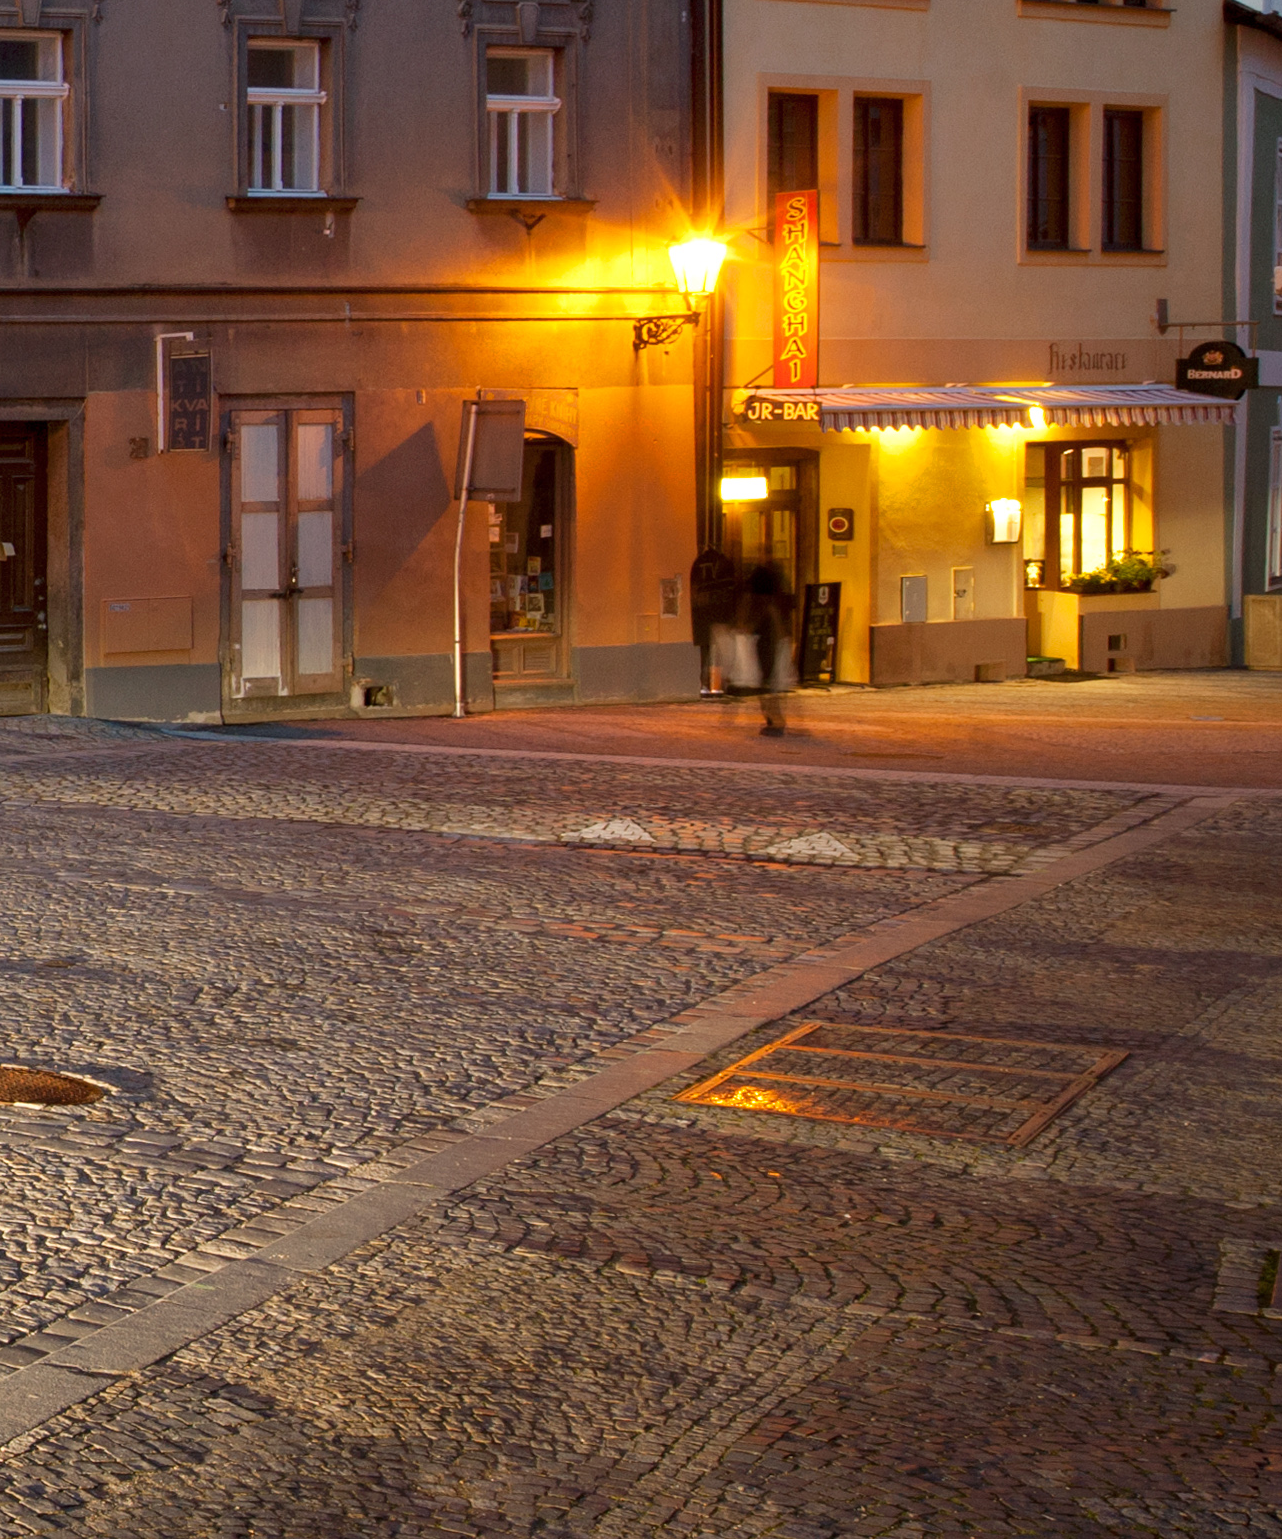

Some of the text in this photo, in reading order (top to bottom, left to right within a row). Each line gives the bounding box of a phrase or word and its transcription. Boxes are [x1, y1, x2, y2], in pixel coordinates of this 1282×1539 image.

[780, 197, 809, 383] SHANGHAI
[1047, 342, 1128, 375] Restaurace
[1187, 367, 1242, 379] BERNARD
[748, 402, 819, 420] JR-BAR
